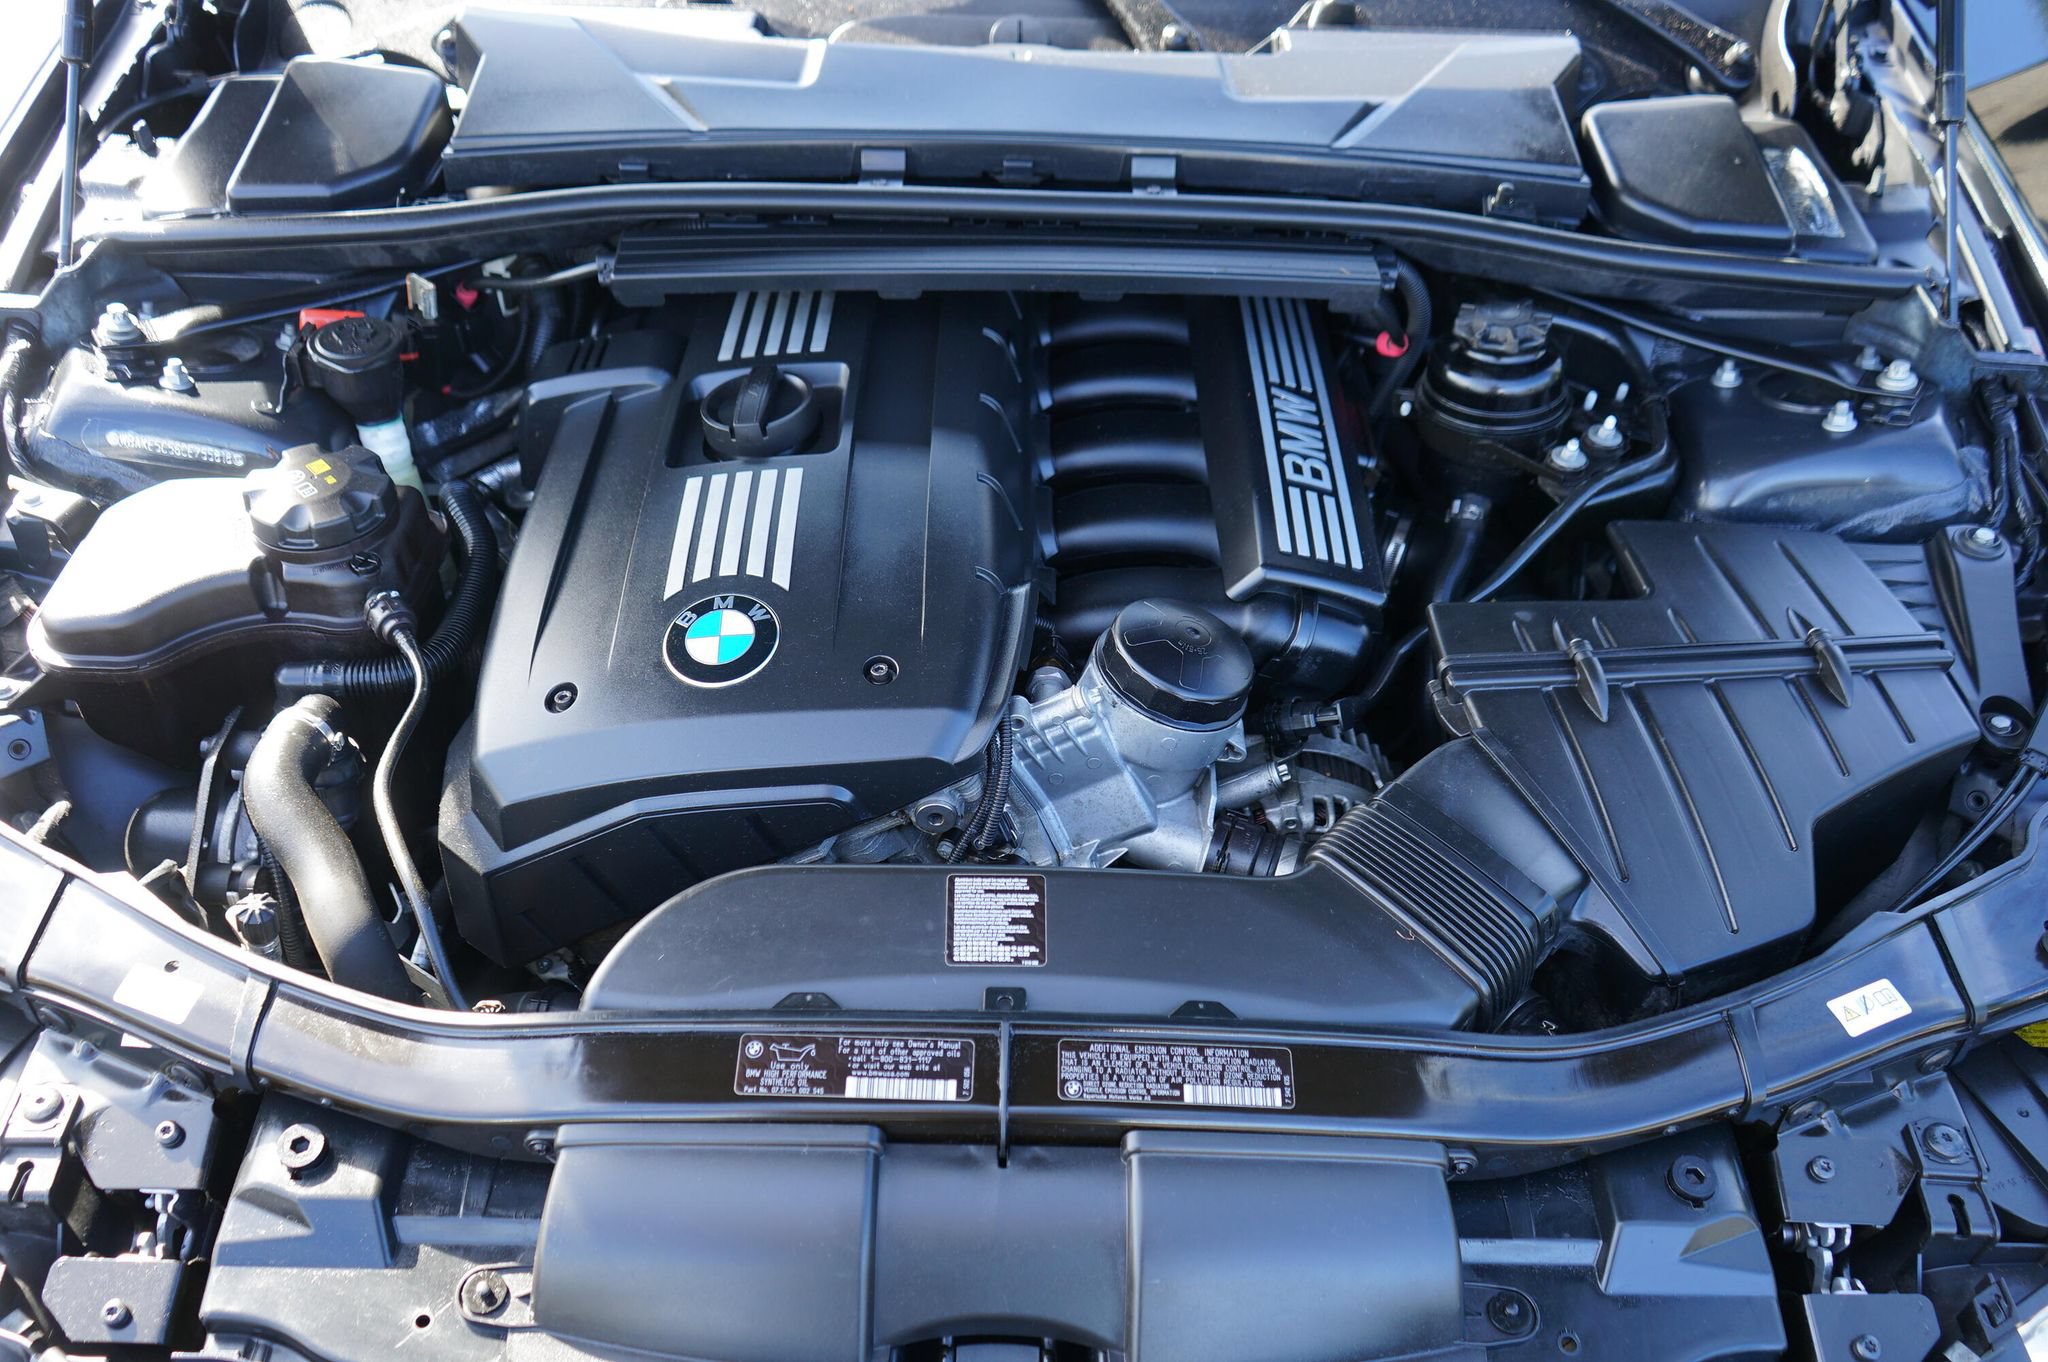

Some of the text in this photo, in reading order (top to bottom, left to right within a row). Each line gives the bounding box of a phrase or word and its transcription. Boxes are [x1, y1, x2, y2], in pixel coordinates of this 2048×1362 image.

[1270, 386, 1333, 492] BMW
[676, 596, 771, 628] BMW
[839, 1038, 851, 1046] For
[875, 1039, 888, 1047] info
[908, 1040, 934, 1048] Owner's
[938, 1041, 960, 1049] Manual
[838, 1046, 850, 1054] For
[862, 1047, 875, 1055] list
[879, 1047, 886, 1055] of
[890, 1048, 908, 1056] other
[913, 1049, 943, 1057] approved
[1090, 1044, 1249, 1057] ADDITIONAL EMISSION CONTROL INFORMATION
[1062, 1058, 1077, 1066] THAT
[1104, 1060, 1131, 1068] ELEMENT
[1163, 1062, 1189, 1070] VEHICLE
[1079, 1052, 1106, 1060] VEHICLE
[1120, 1053, 1150, 1061] EQUIPPED
[1208, 1057, 1241, 1065] REDUCTION
[1244, 1058, 1275, 1066] RADIATOR
[771, 1061, 809, 1070] Use only
[746, 1069, 827, 1079] BMW HIGH PERFORMANCE
[1152, 1069, 1178, 1077] WITHOUT
[1182, 1070, 1220, 1078] EQUIVALENT
[1247, 1073, 1280, 1081] REDUCTION
[760, 1078, 808, 1087] SYNTHETIC OIL
[1186, 1077, 1220, 1085] POLLUTION
